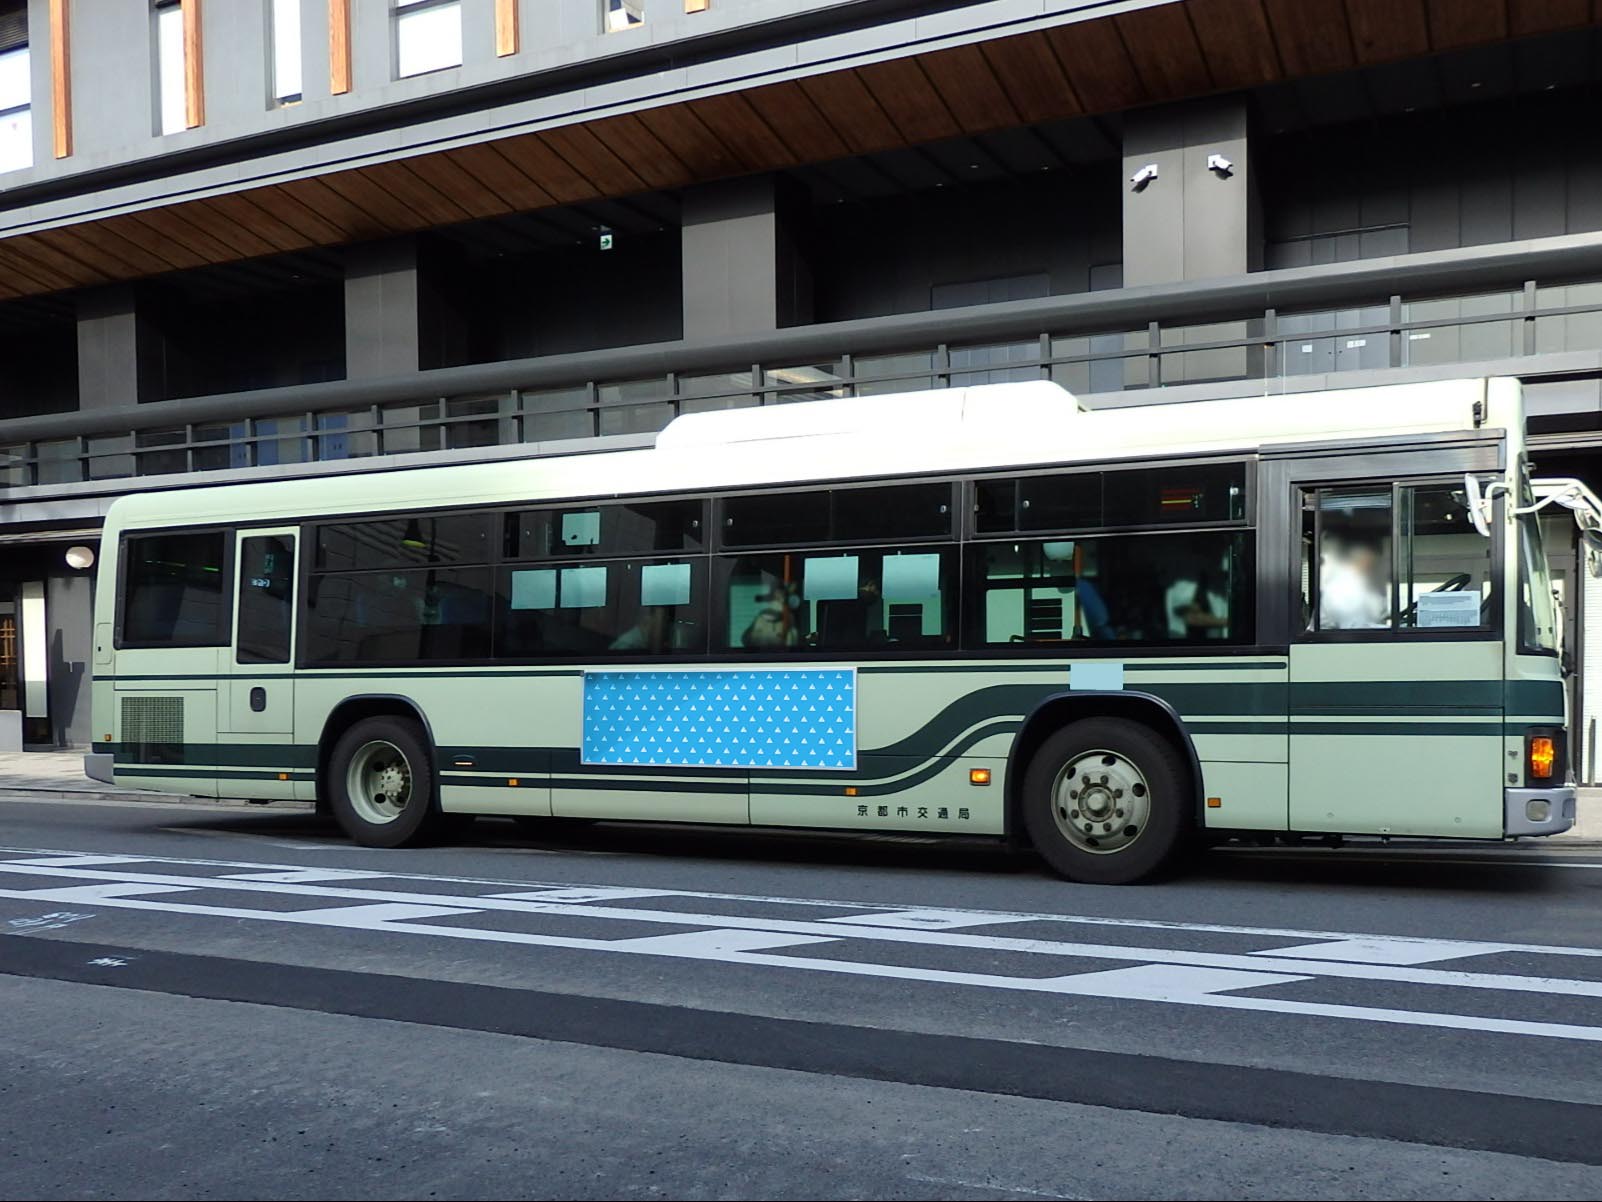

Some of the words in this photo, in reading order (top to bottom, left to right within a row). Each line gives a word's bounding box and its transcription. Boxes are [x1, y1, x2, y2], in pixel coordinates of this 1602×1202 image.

[857, 804, 970, 820] 京都市交通局
